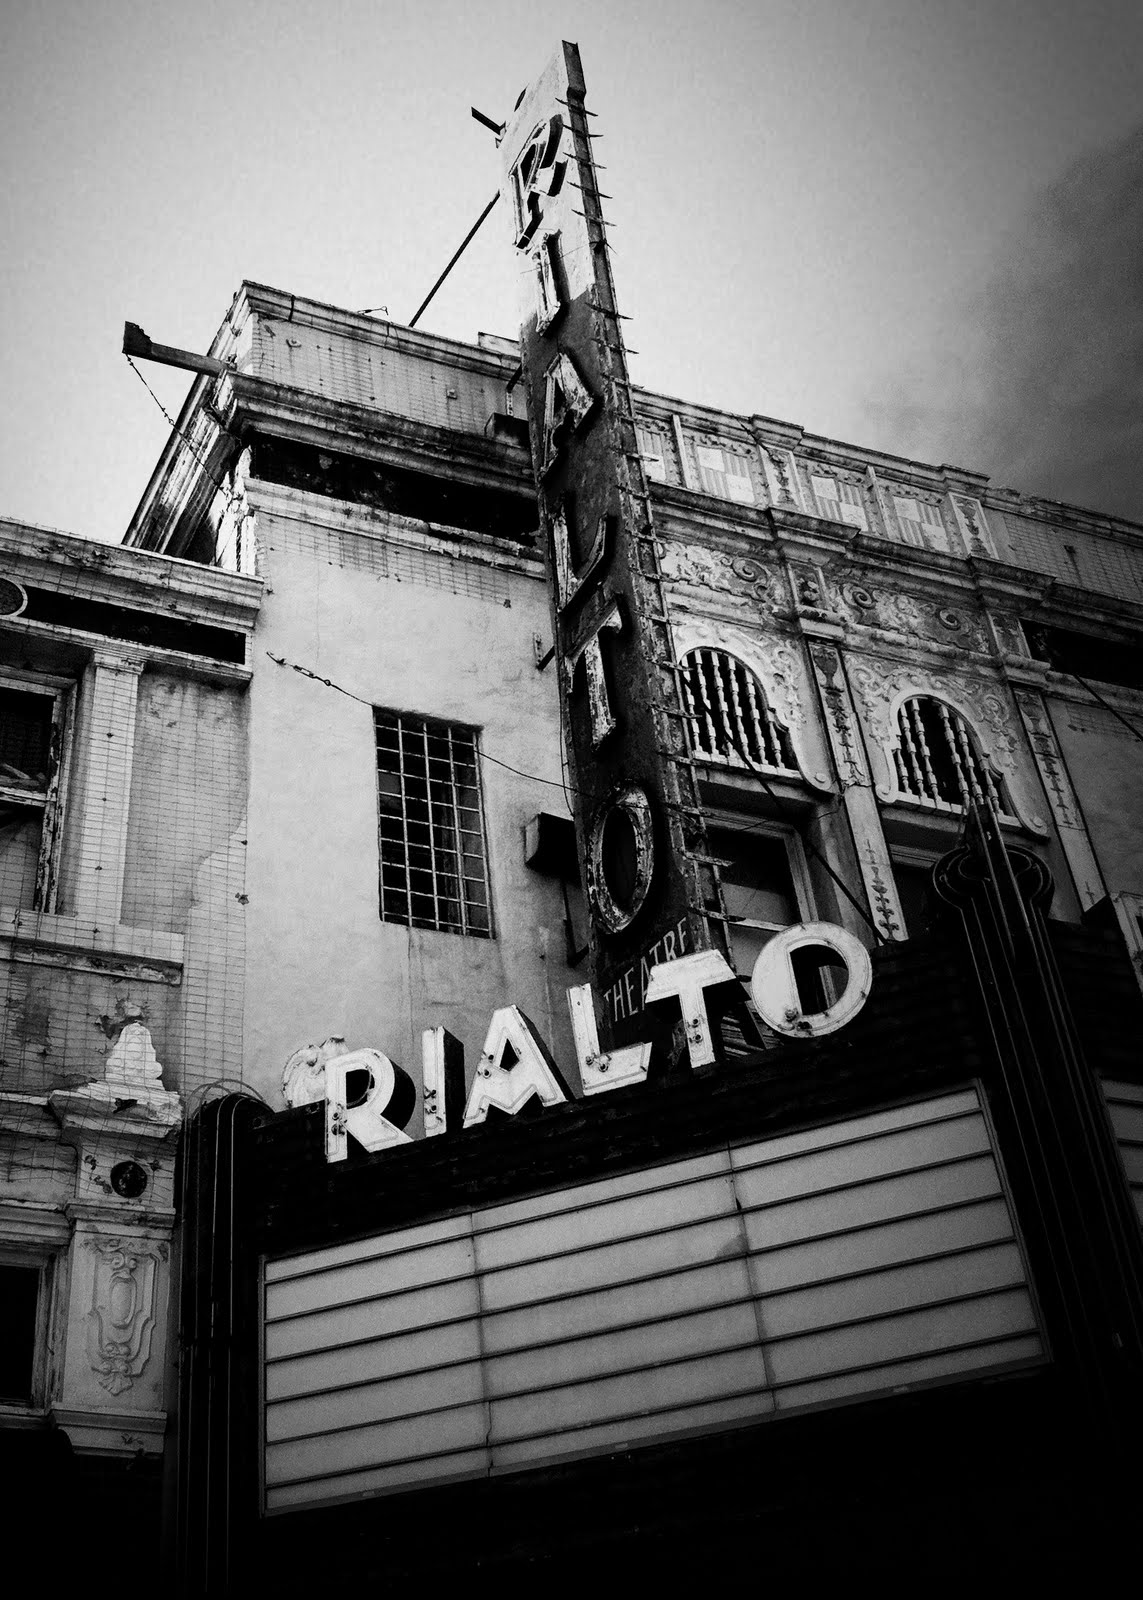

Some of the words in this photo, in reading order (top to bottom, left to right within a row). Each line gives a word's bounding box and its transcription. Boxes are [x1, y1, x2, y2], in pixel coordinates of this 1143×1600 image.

[508, 113, 655, 934] RIALTO
[325, 921, 873, 1163] RIALTO
[603, 917, 687, 1022] THEATRE
